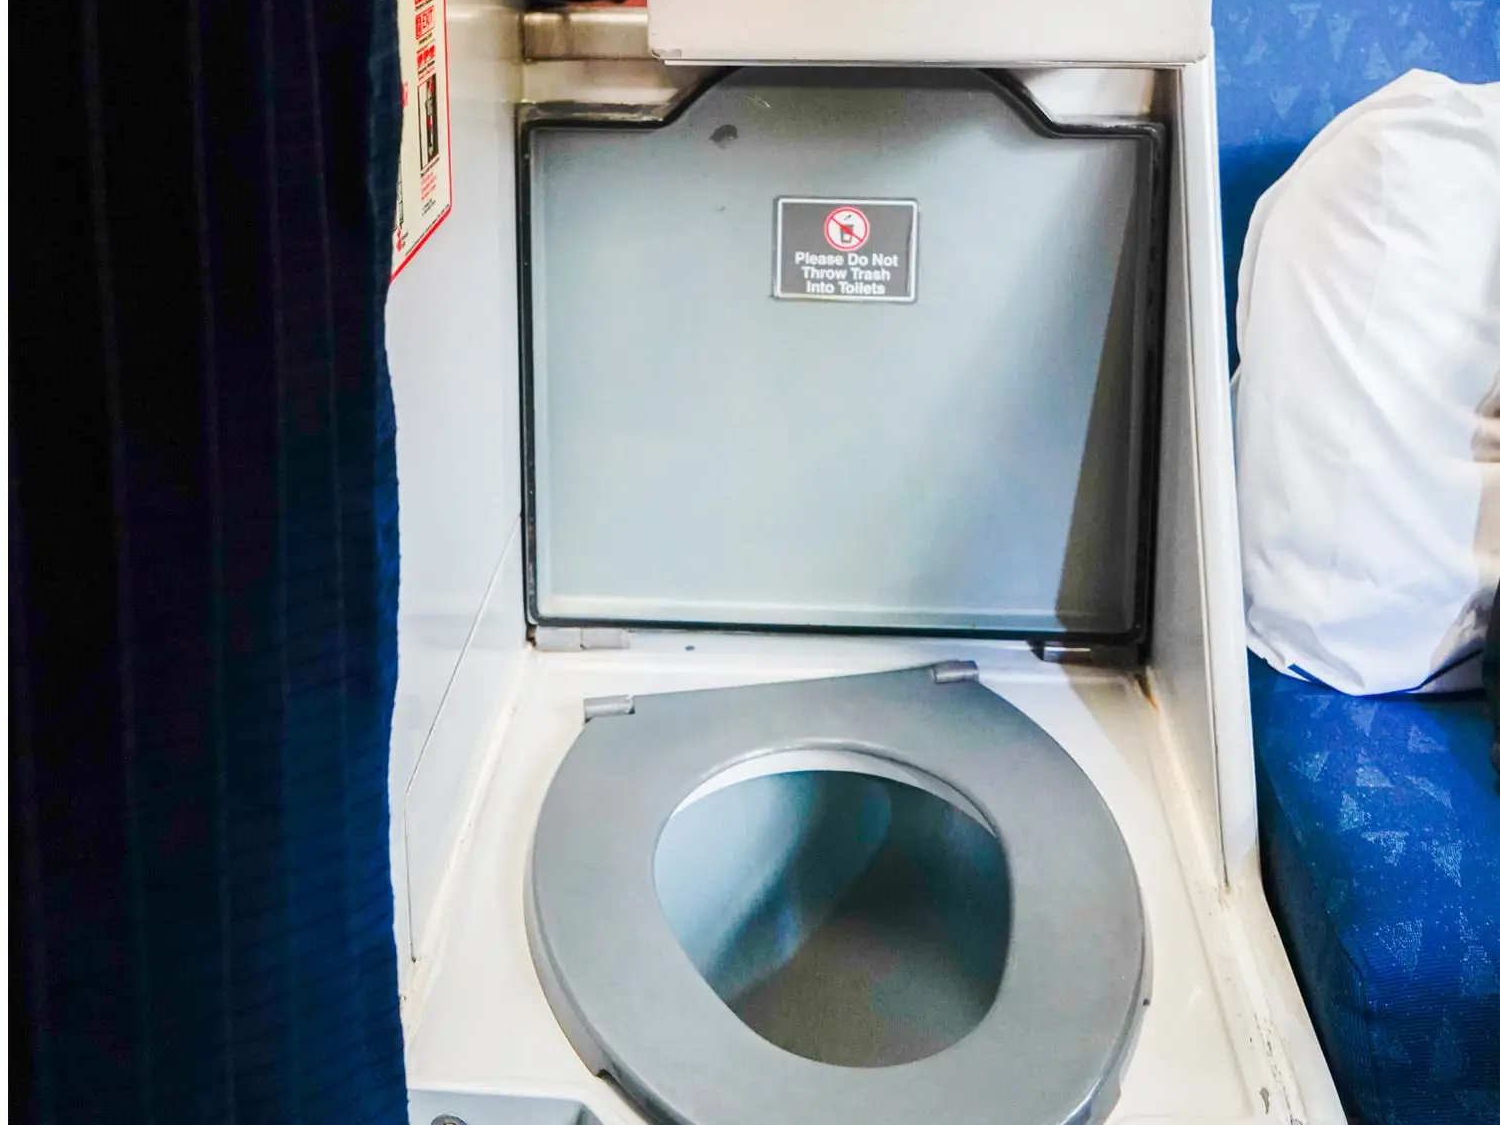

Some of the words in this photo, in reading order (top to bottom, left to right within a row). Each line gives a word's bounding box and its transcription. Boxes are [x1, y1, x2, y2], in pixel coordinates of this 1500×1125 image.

[794, 251, 844, 265] Please
[848, 253, 869, 265] Do
[872, 253, 898, 267] Not
[802, 266, 847, 280] Throw
[851, 267, 891, 281] Trash
[806, 280, 835, 294] Into
[838, 281, 886, 295] Toilets
